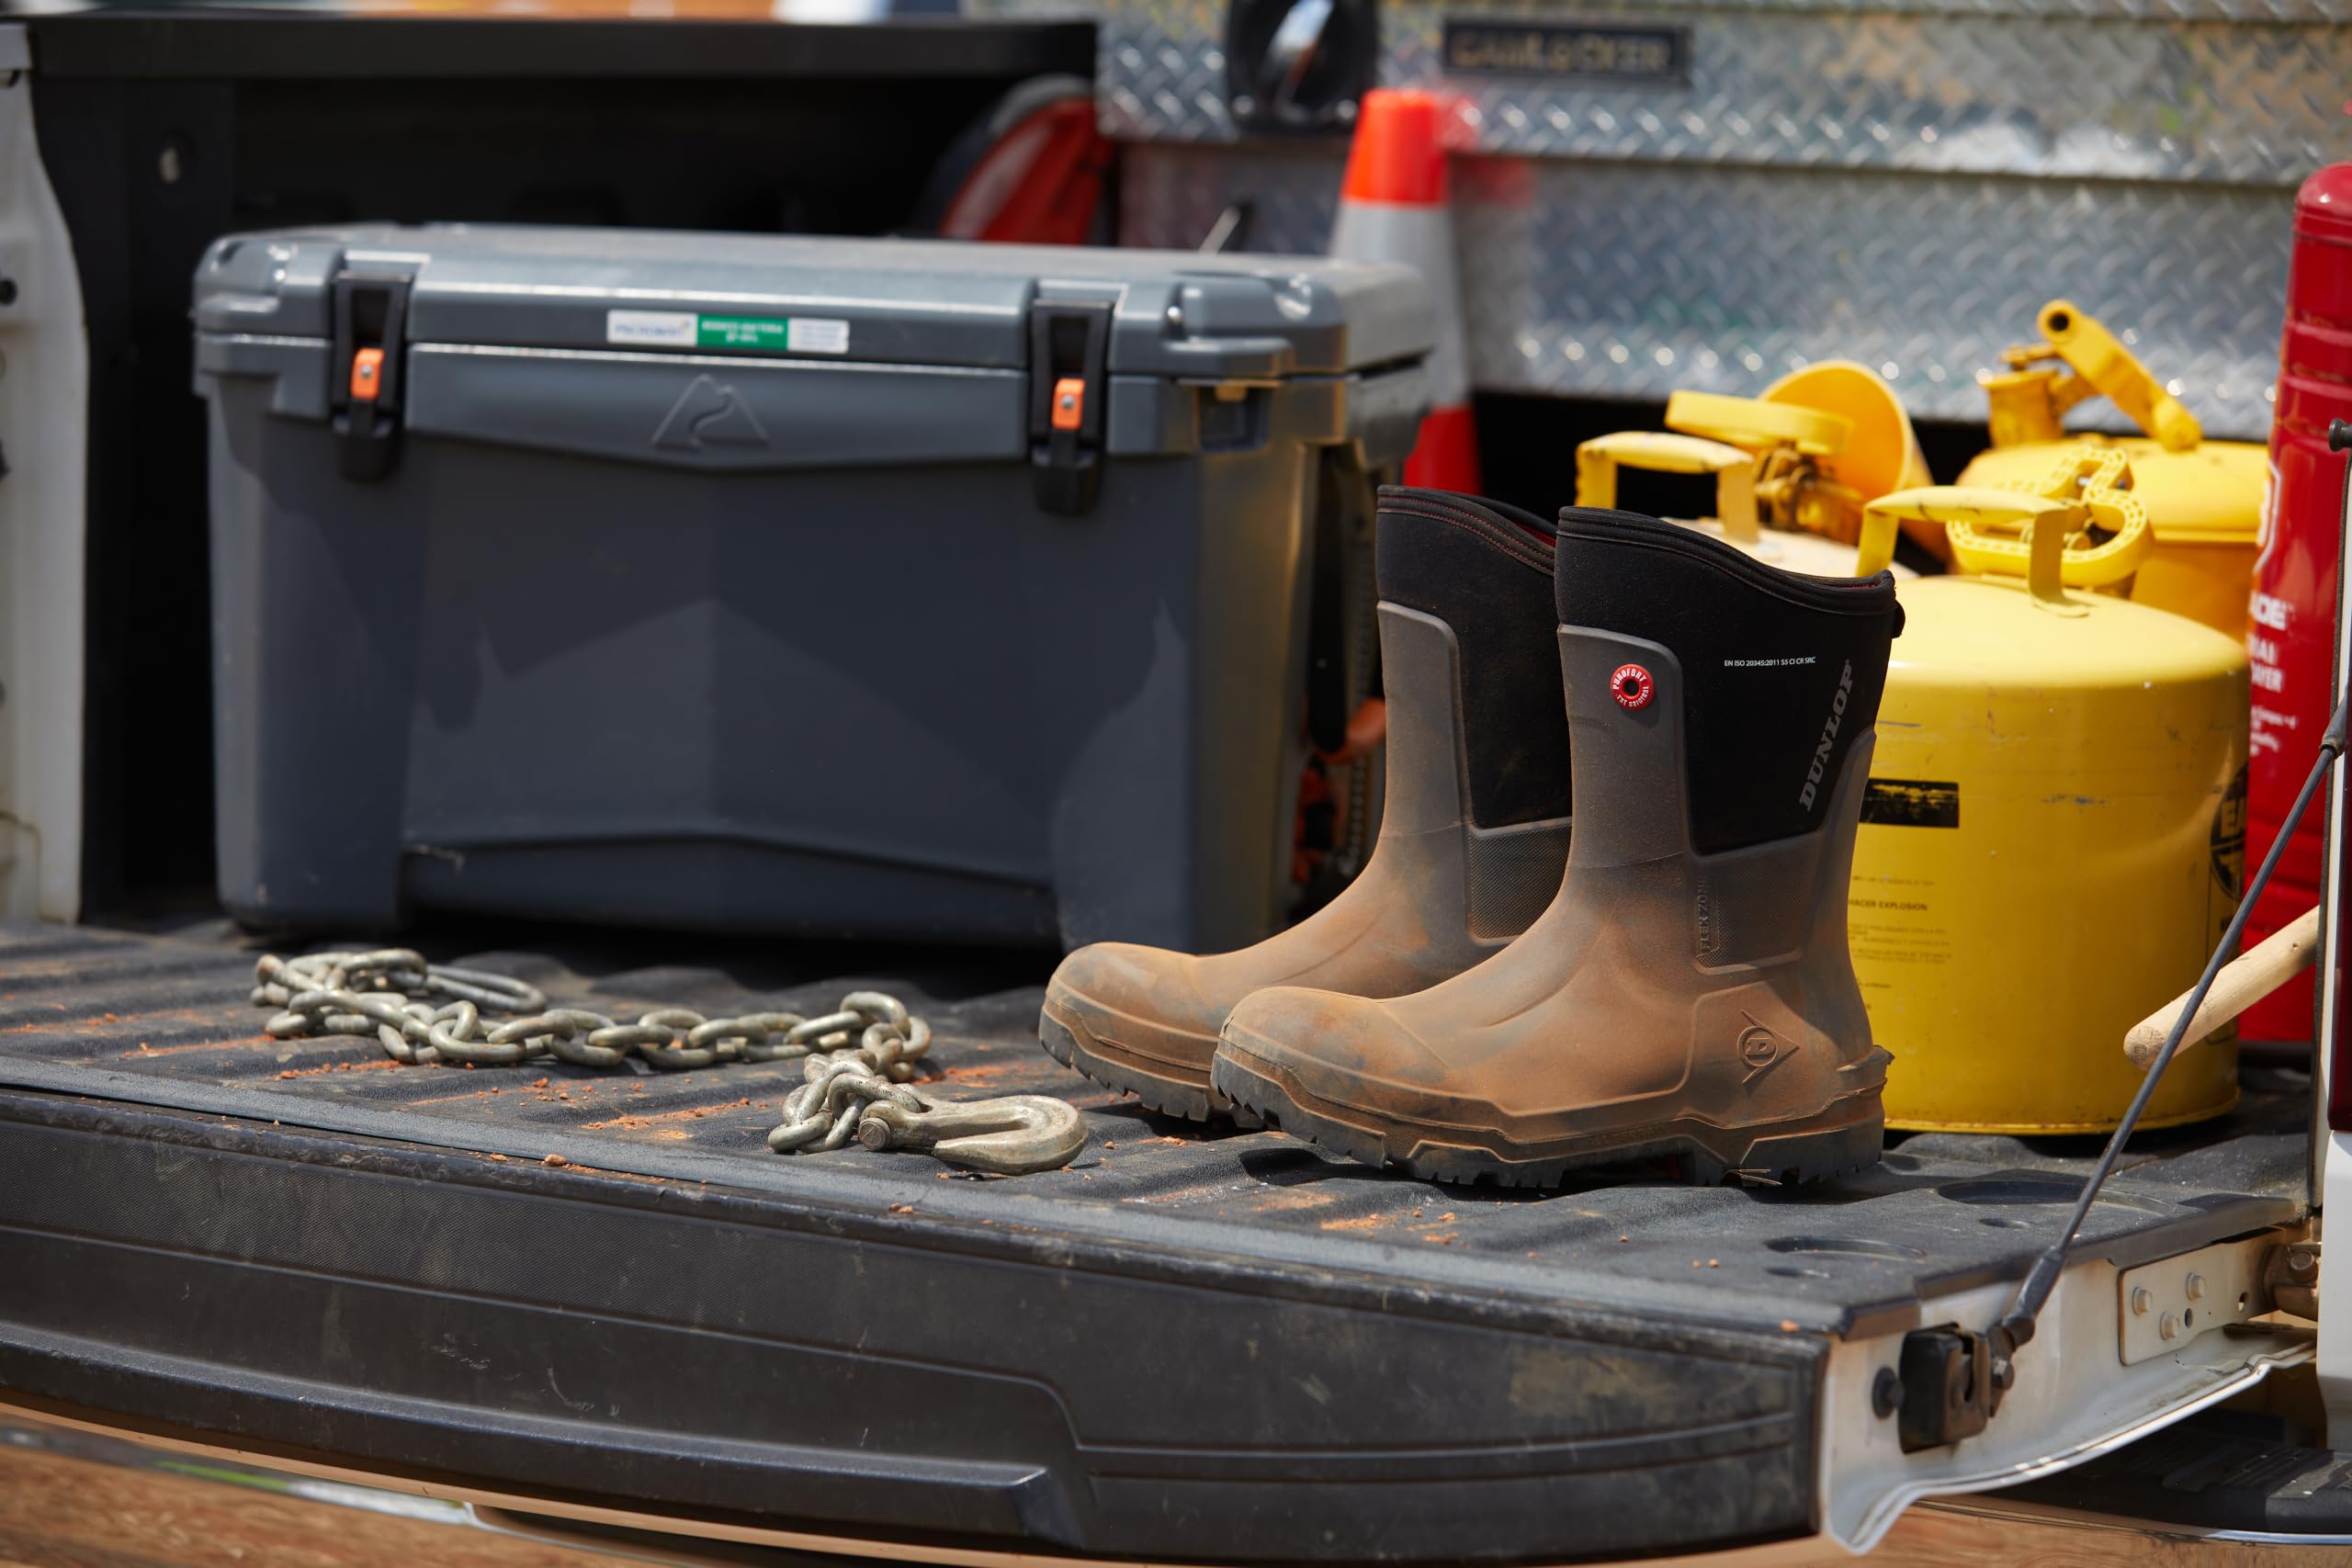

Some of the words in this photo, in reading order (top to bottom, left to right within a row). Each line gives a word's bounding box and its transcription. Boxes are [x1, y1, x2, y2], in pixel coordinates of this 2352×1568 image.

[1804, 656, 1816, 664] SRC
[1612, 668, 1647, 691] PUROFORT
[1616, 694, 1628, 706] THE
[1628, 685, 1650, 707] ORIGINAL
[1799, 662, 1853, 812] DUNLOP
[1879, 900, 1928, 911] EXPLOSION
[1746, 1037, 1777, 1056] D
